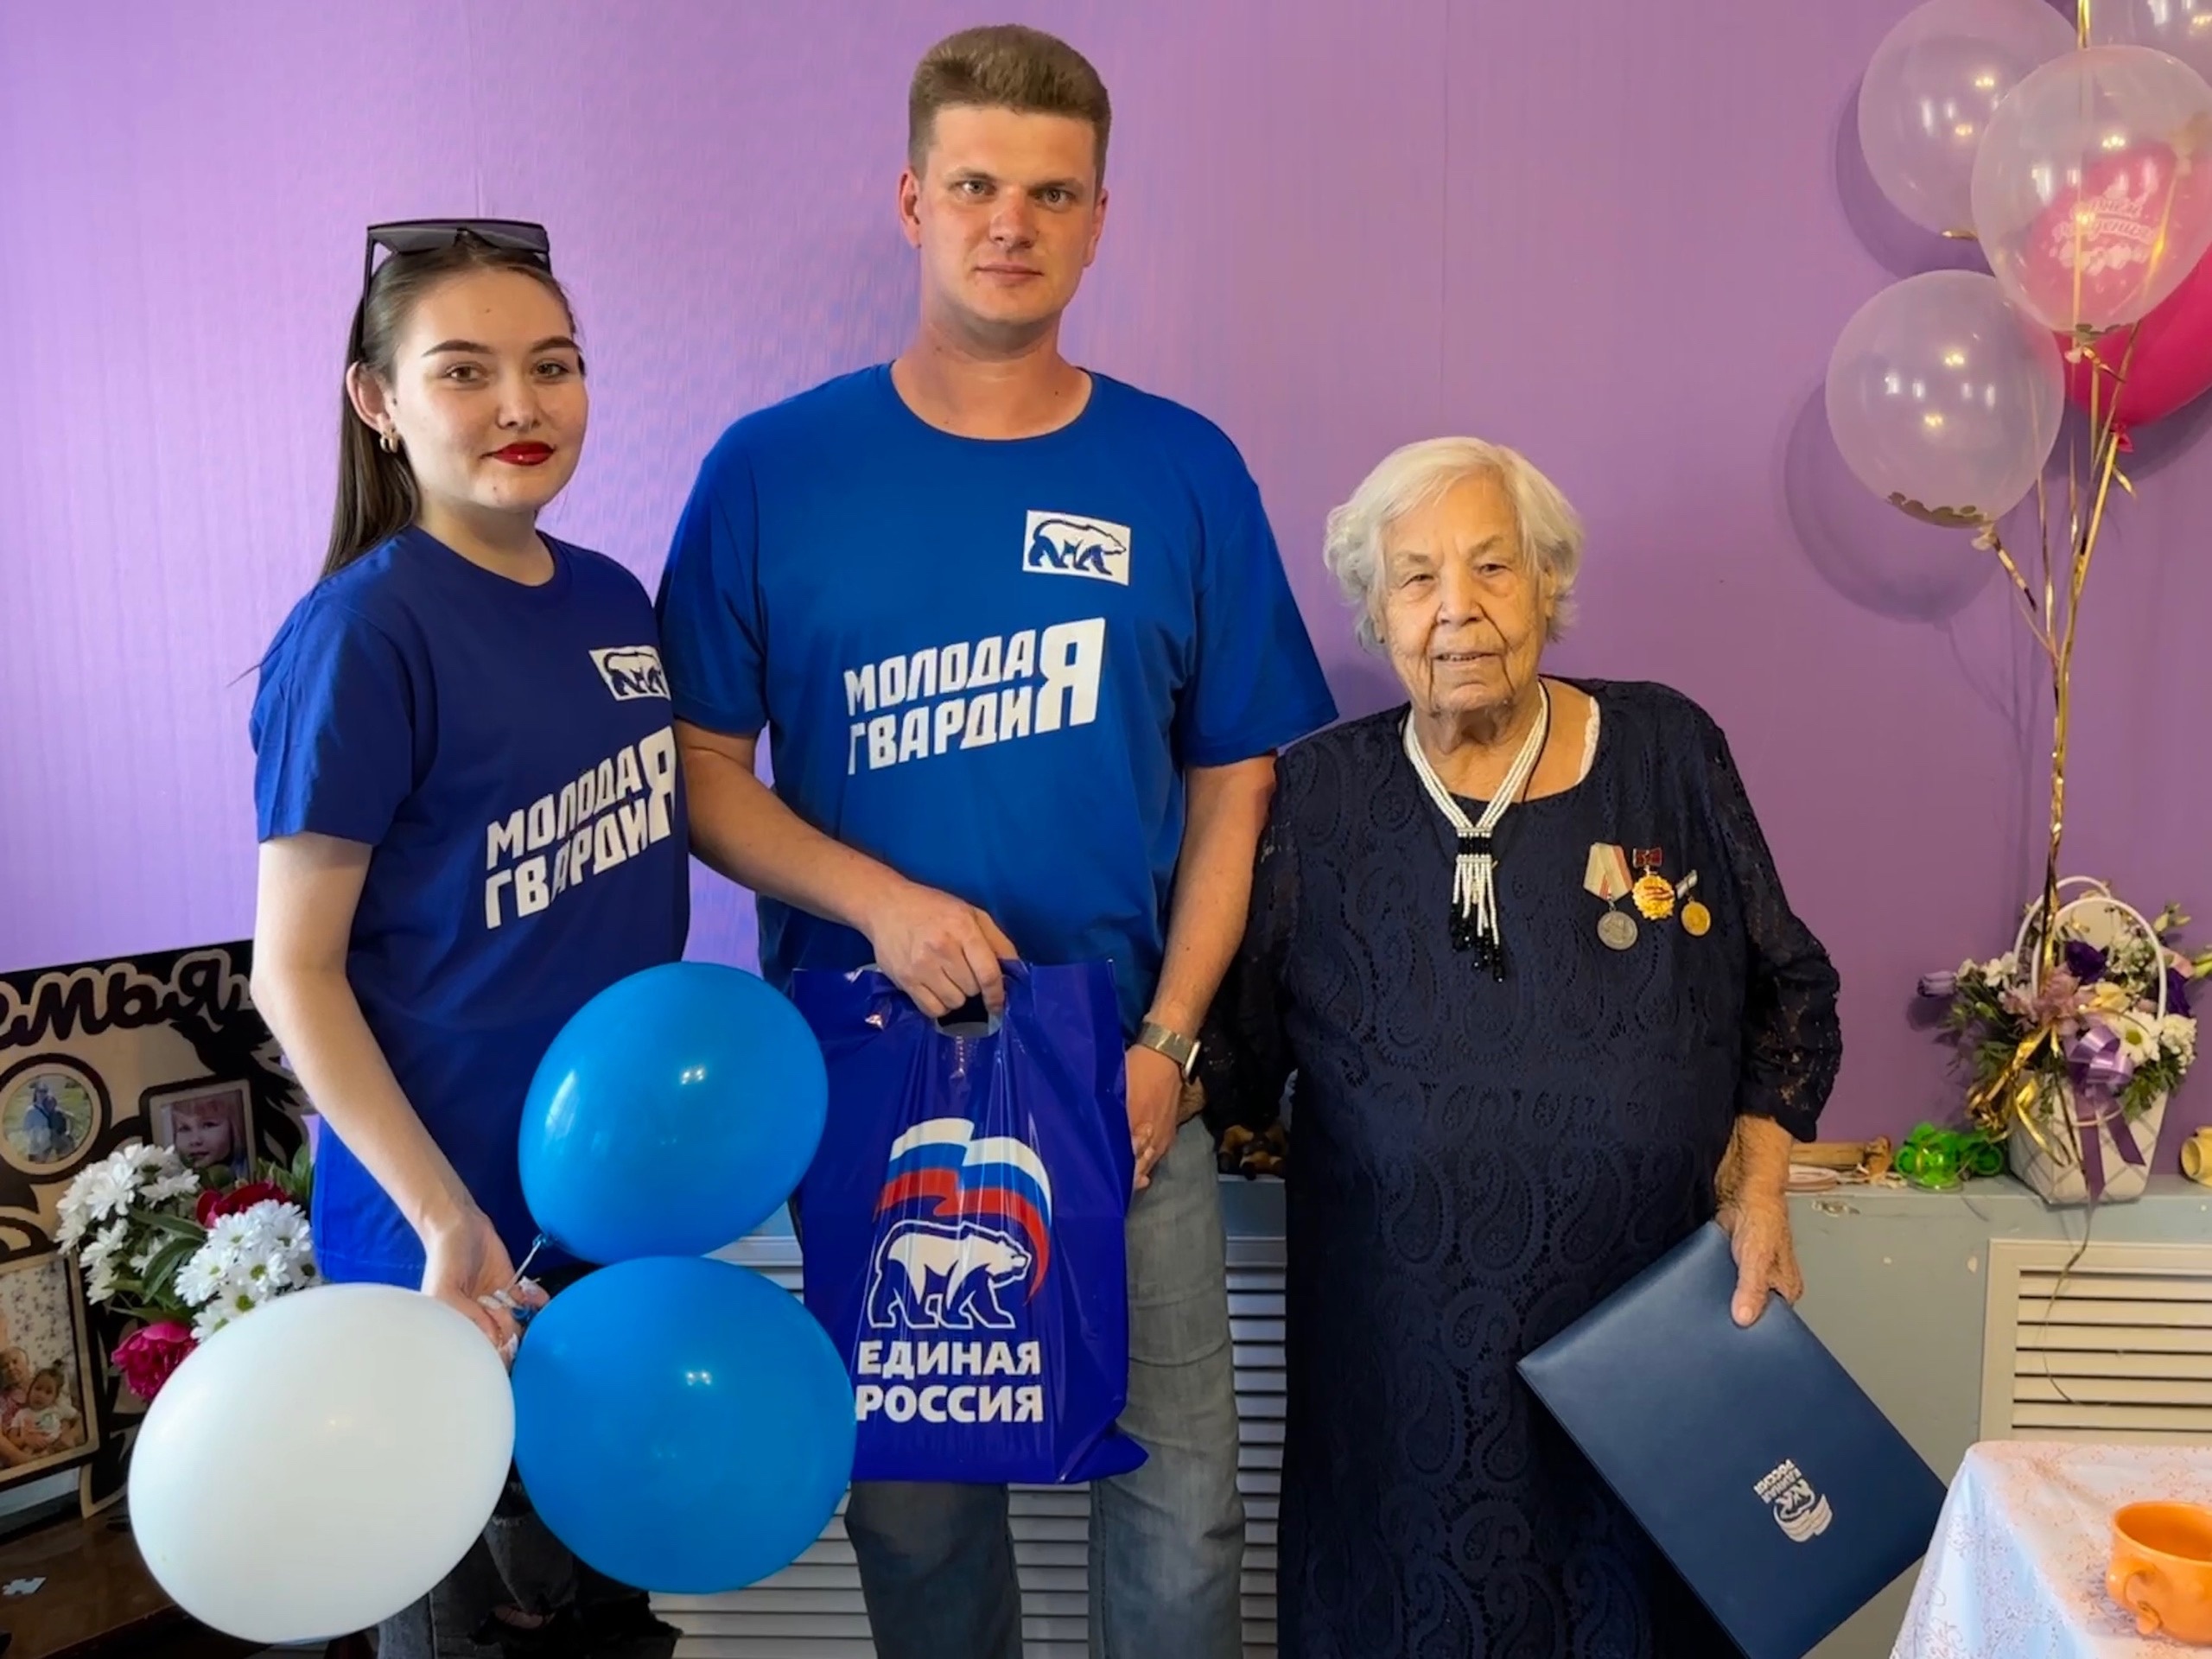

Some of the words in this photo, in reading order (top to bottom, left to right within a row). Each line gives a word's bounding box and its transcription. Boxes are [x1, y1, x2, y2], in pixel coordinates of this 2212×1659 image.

[843, 617, 1106, 734] МОЛОДАЯ
[486, 726, 677, 870] МОЛОДАЯ
[857, 1339, 1041, 1380] ЕДИНАЯ
[855, 1384, 1044, 1423] РОССИЯ
